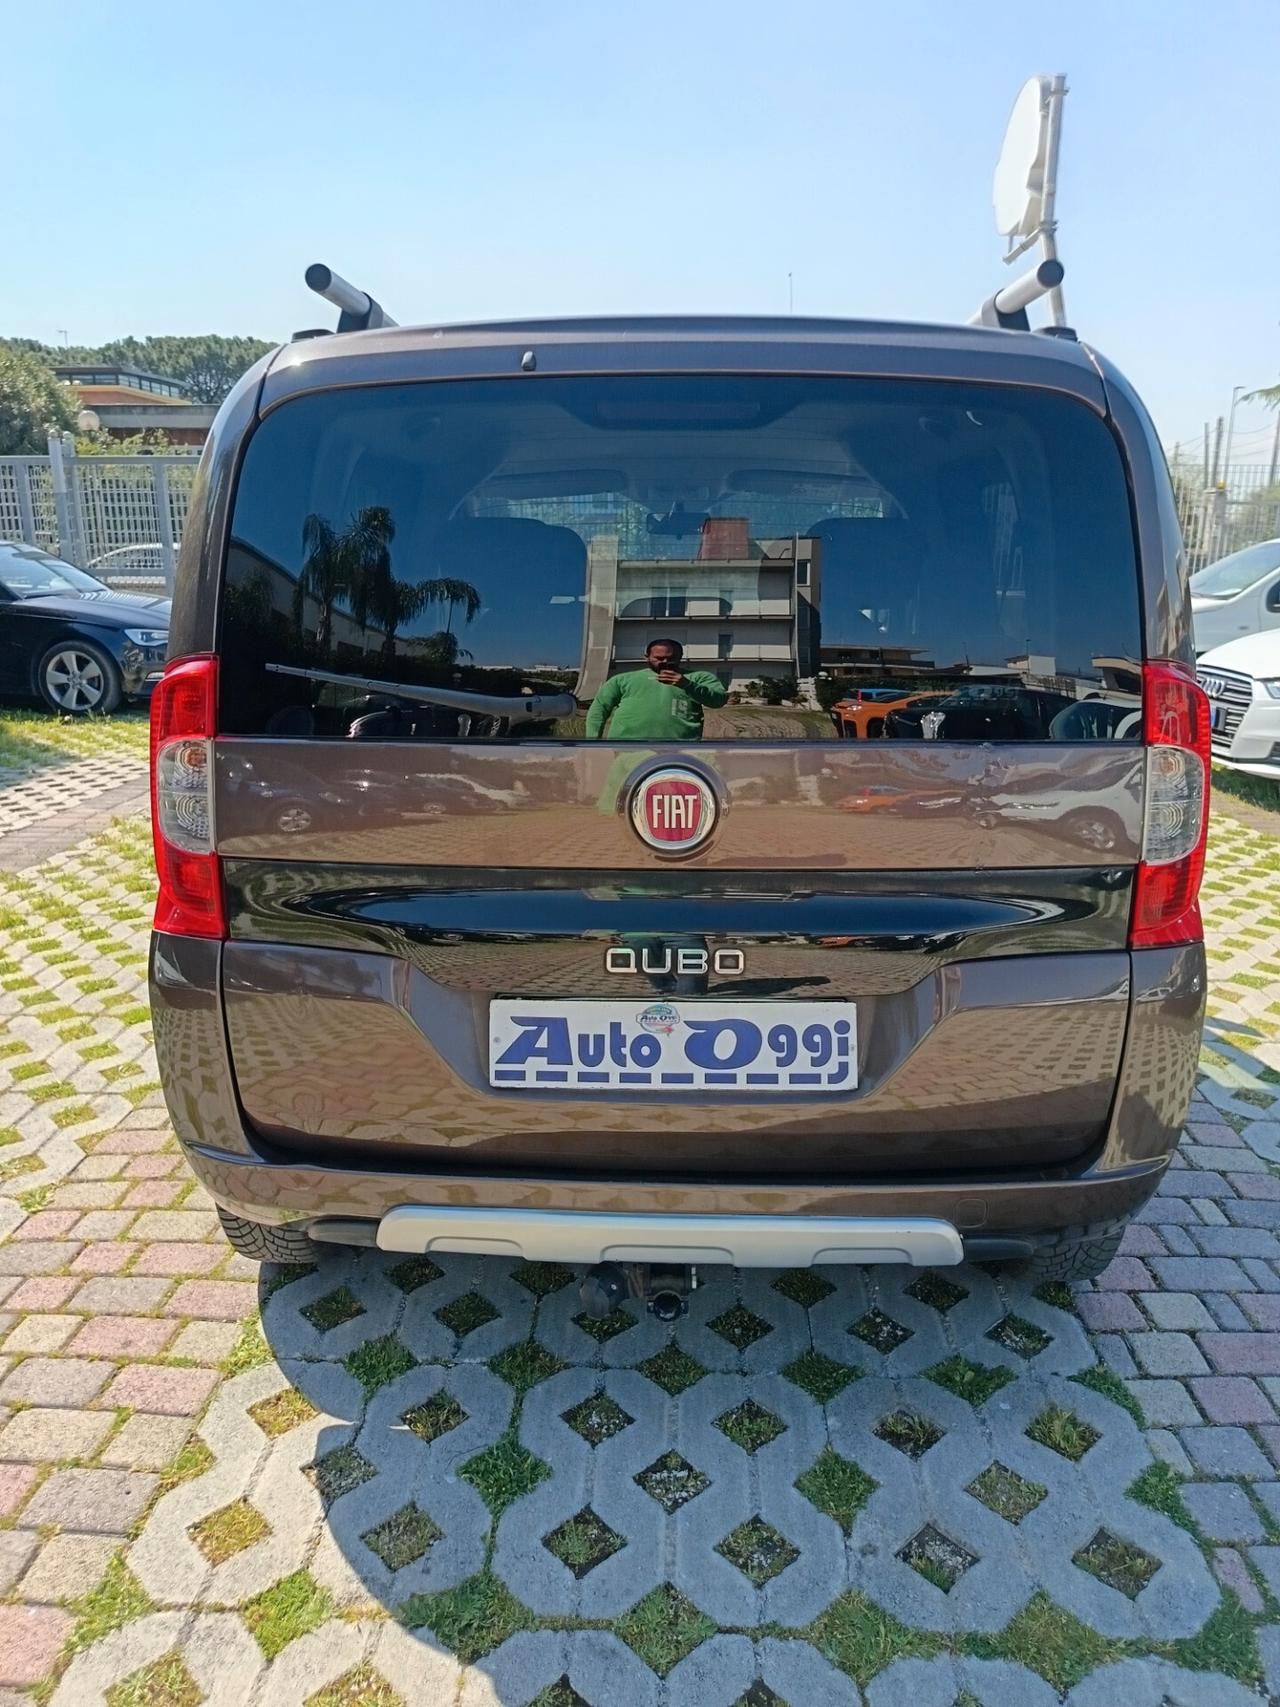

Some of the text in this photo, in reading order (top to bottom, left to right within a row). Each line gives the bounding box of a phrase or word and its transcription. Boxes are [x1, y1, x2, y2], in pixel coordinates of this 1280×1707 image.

[652, 794, 698, 829] FIAT
[605, 948, 745, 974] QUBO
[495, 1016, 851, 1084] Auto Oggi
